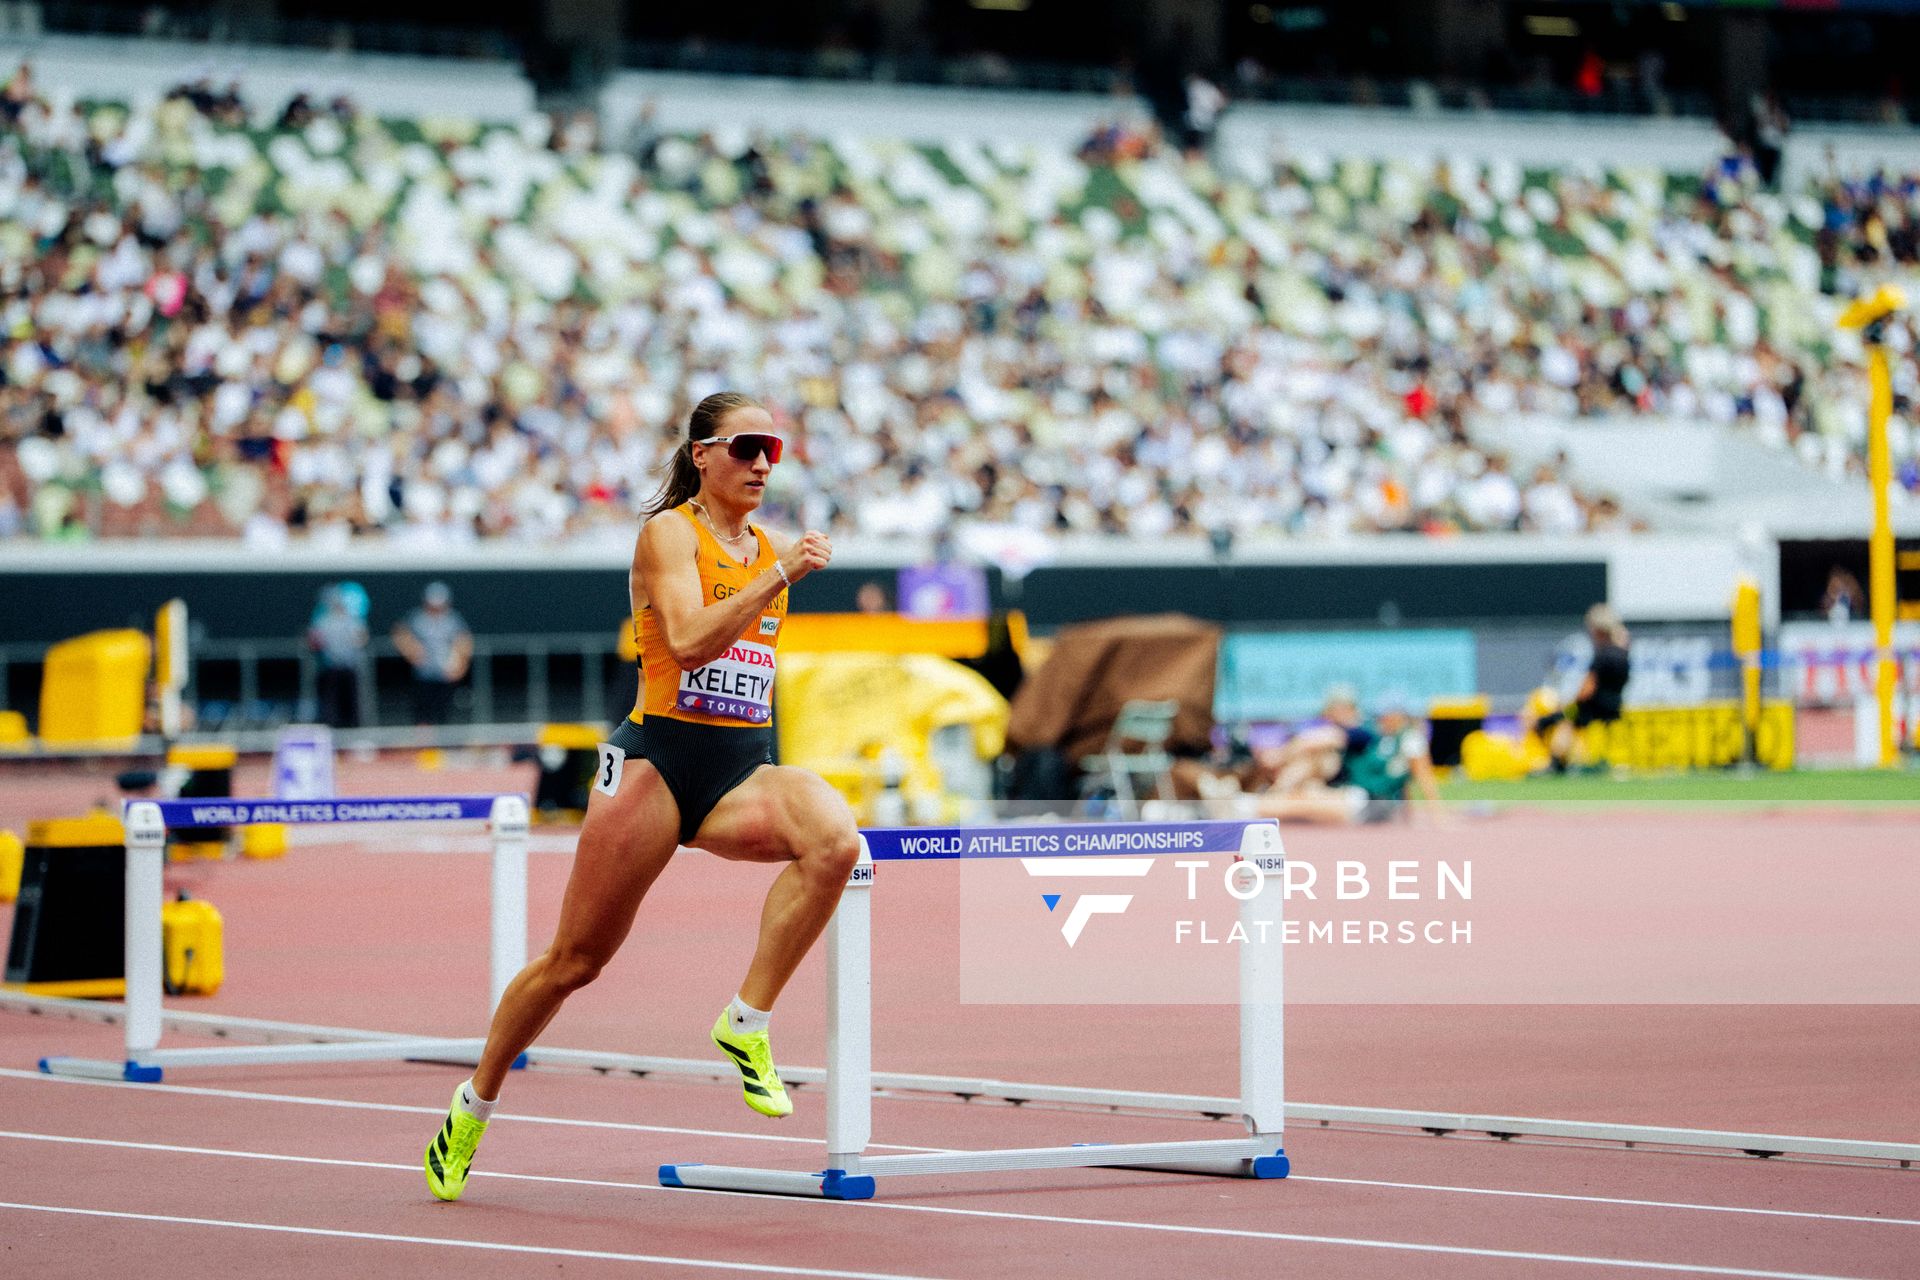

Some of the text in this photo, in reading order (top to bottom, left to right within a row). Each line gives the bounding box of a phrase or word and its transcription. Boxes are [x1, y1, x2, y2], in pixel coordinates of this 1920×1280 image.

[713, 583, 785, 611] GENY
[719, 647, 775, 669] NDA
[687, 667, 770, 700] KELETY
[603, 752, 614, 787] 3
[192, 802, 462, 823] WORLD ATHLETICS CHAMPIONSHIPS
[900, 831, 1204, 854] WORLD ATHLETICS CHAMPIONSHIPS
[850, 868, 872, 880] SHI
